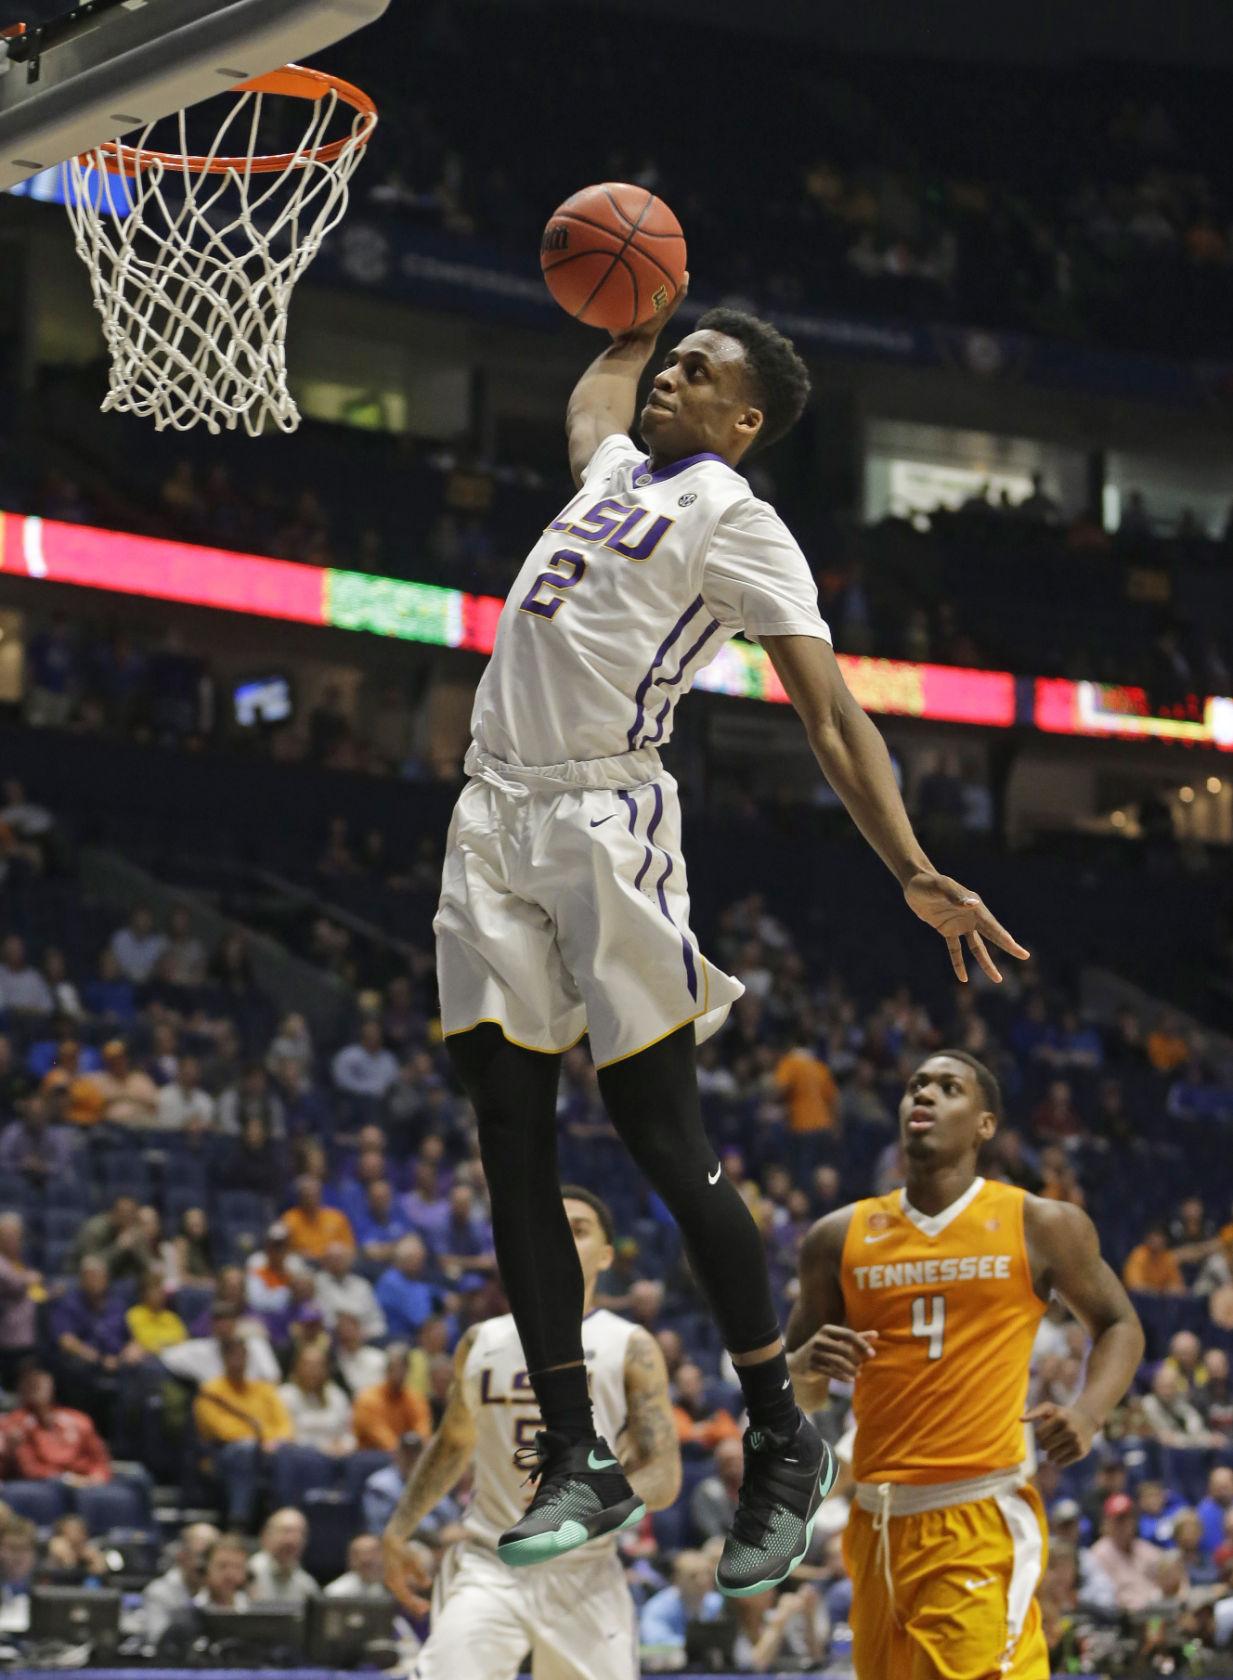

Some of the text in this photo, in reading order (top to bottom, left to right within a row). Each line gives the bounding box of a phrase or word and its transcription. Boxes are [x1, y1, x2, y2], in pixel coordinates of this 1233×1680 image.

[543, 494, 676, 562] LSU
[519, 549, 588, 622] 2
[854, 1255, 1012, 1290] TENNESSEE
[911, 1296, 945, 1360] 4
